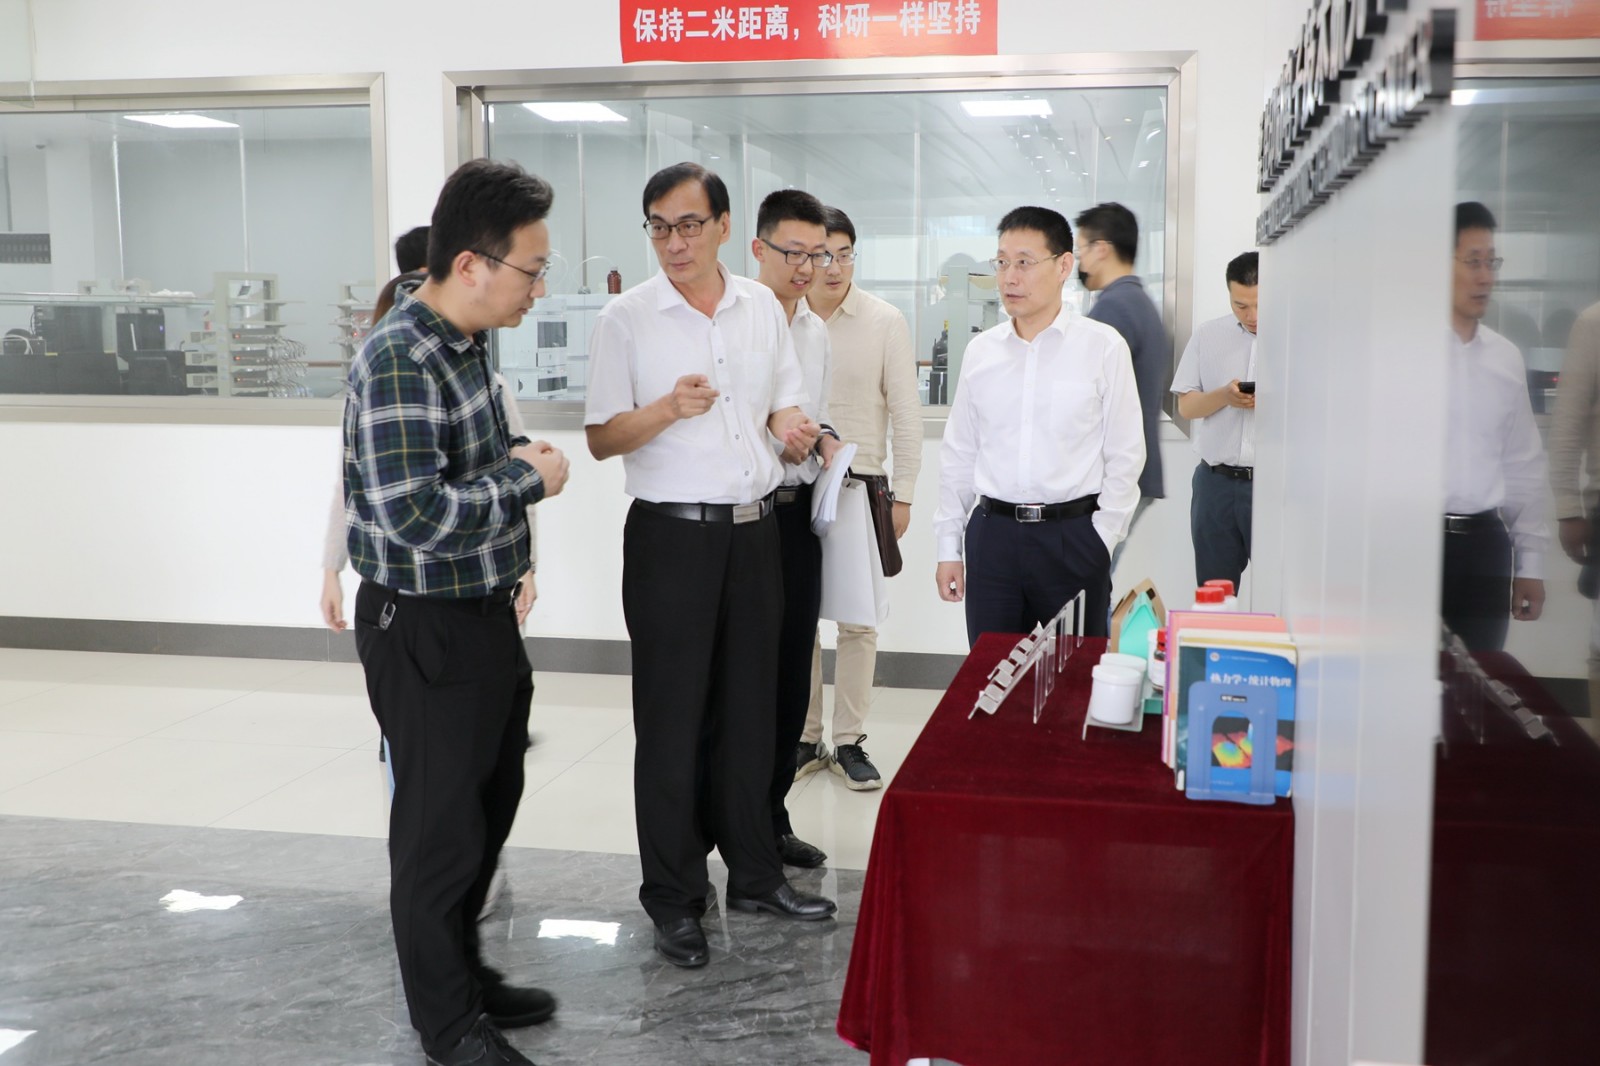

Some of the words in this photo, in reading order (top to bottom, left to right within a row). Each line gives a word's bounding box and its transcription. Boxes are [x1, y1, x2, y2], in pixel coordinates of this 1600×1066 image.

[633, 0, 981, 42] 保持二米距离，科研一样坚持
